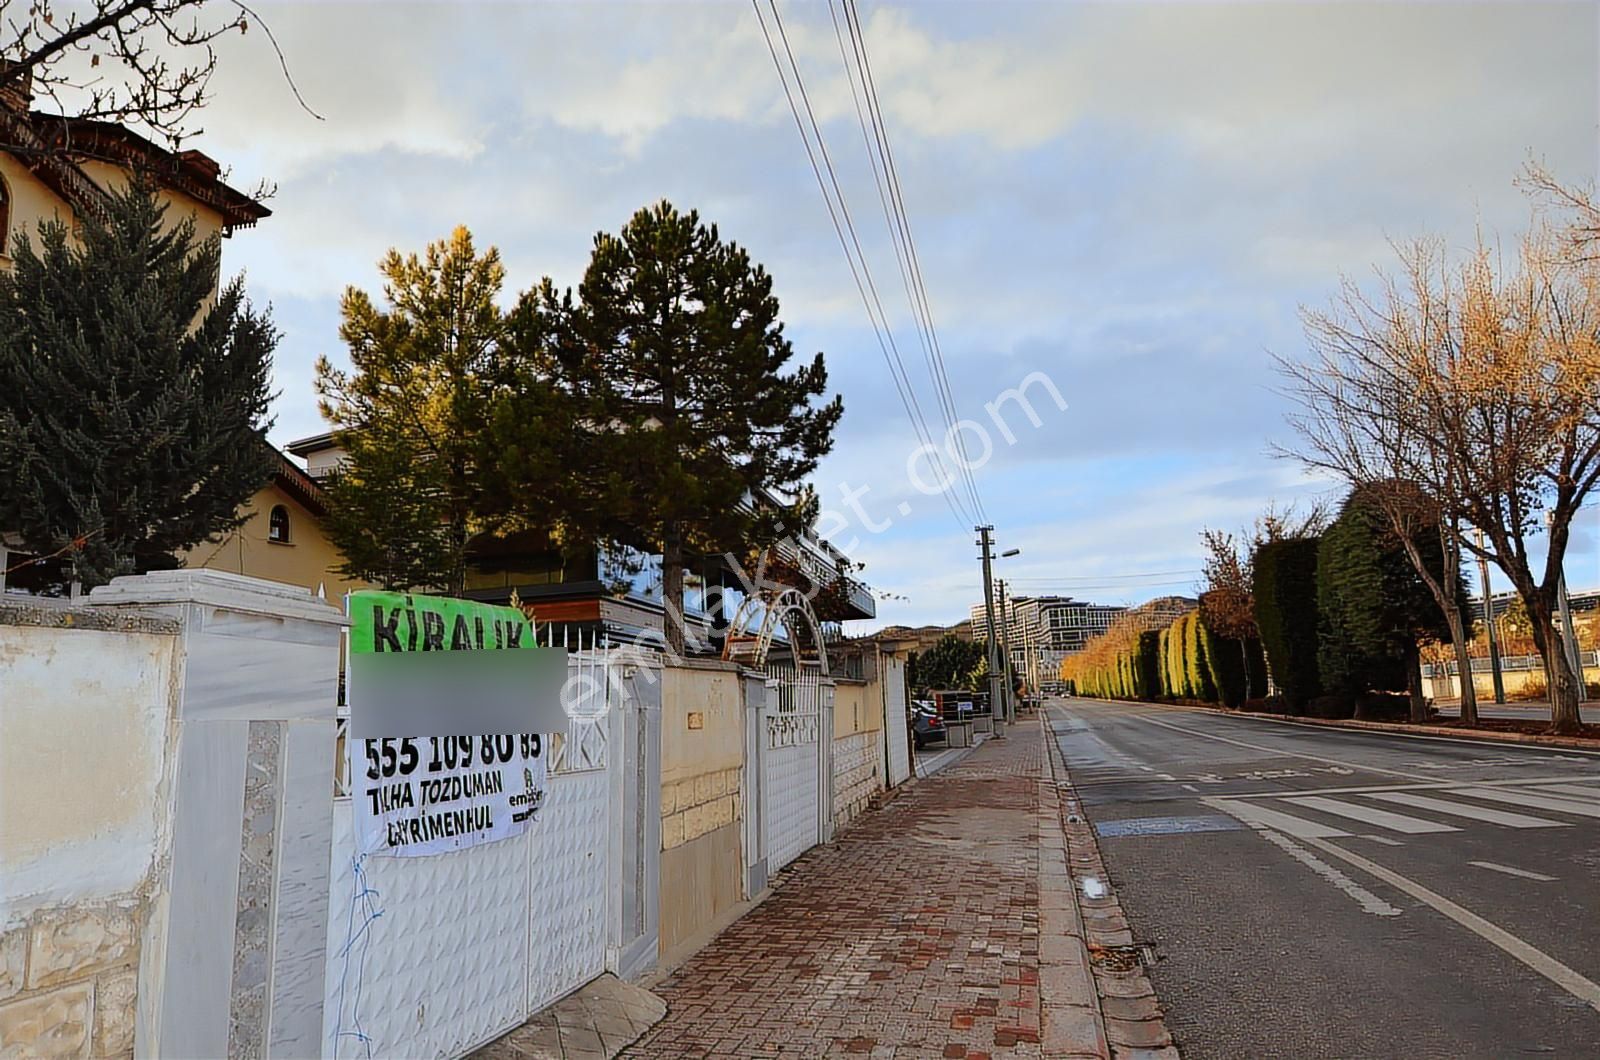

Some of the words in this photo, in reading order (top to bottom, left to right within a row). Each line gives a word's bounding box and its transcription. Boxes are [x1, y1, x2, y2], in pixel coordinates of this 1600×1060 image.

[365, 736, 419, 780] 555
[428, 735, 473, 772] 109
[420, 770, 503, 806] TOZDUMAN
